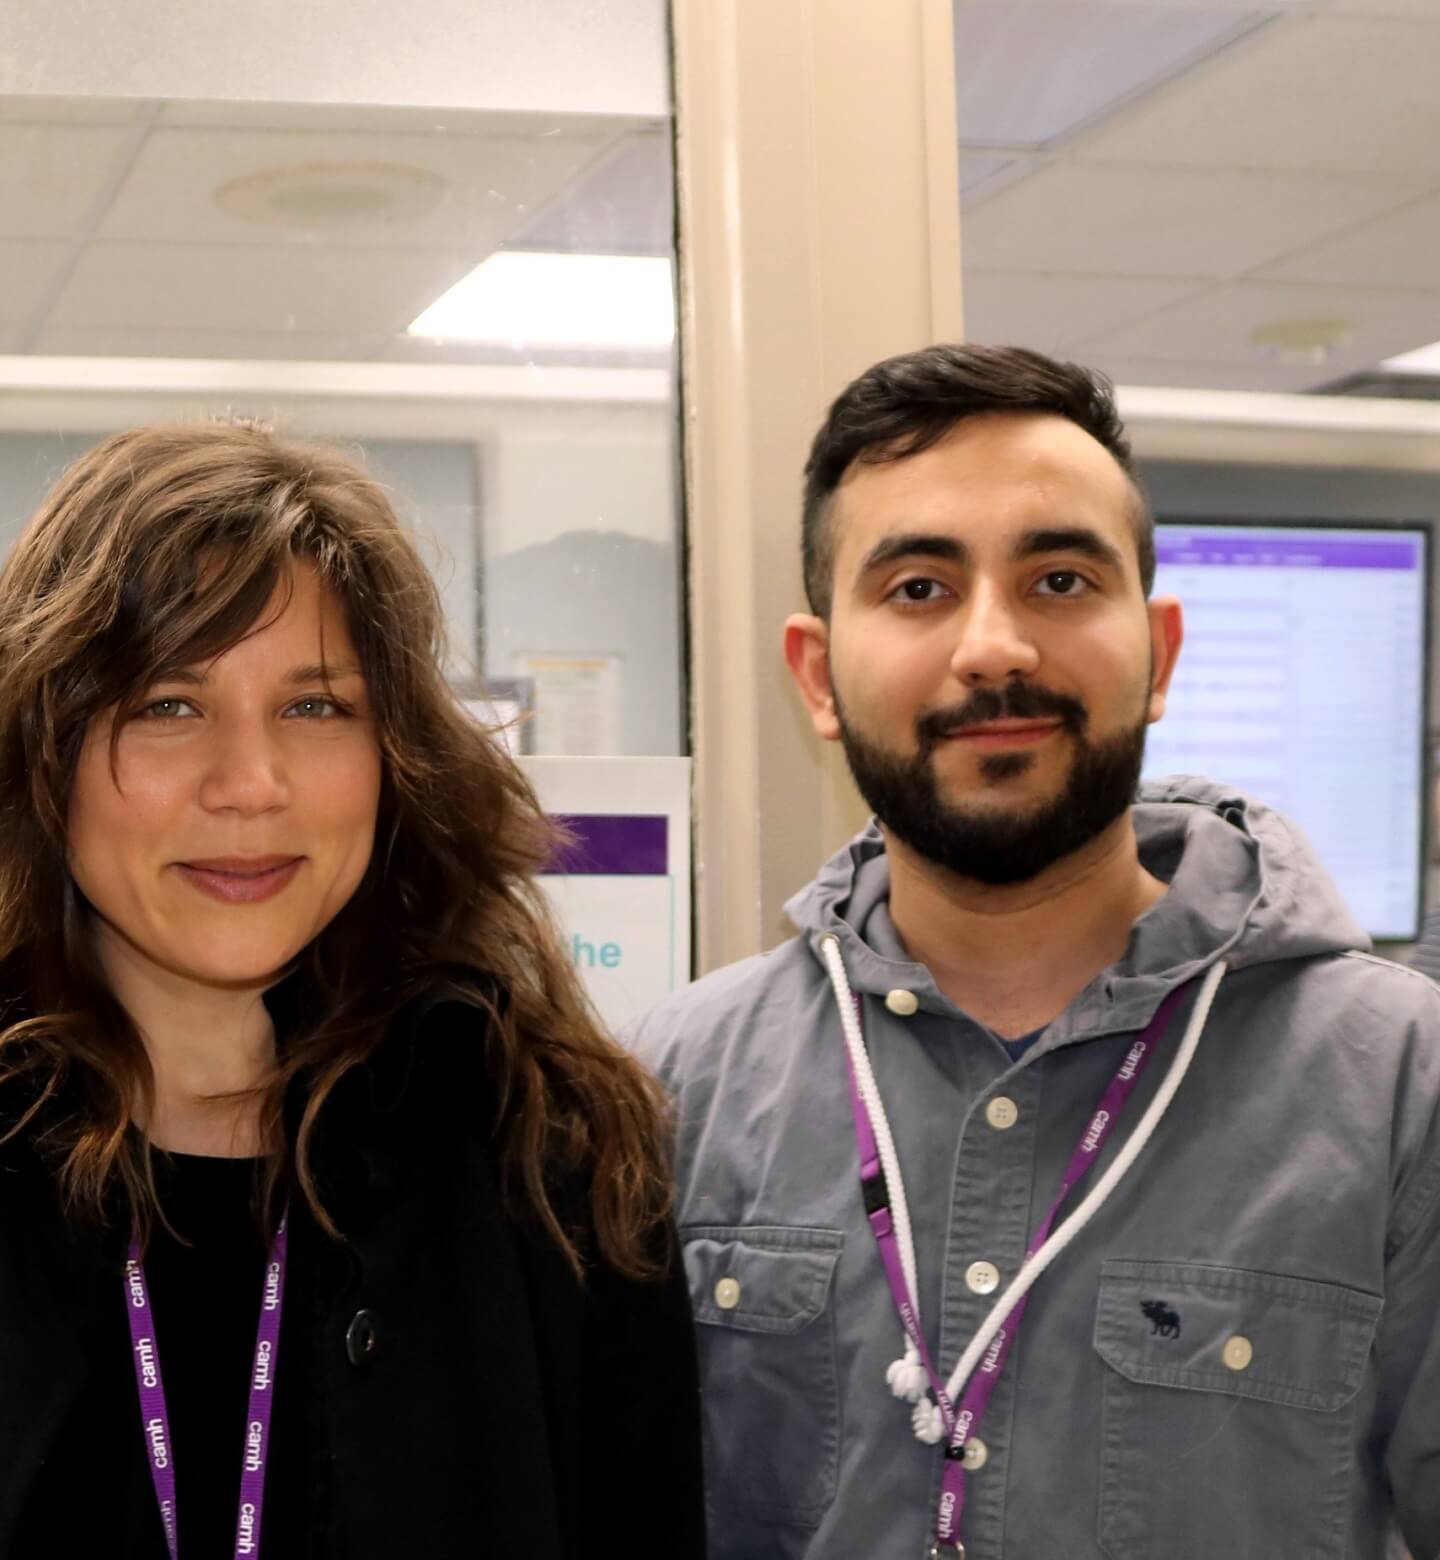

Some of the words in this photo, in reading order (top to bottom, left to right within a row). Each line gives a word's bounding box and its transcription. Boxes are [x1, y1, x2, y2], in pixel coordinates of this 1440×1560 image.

[568, 932, 623, 968] he
[1116, 1041, 1147, 1081] camh
[1081, 1109, 1111, 1153] camh
[263, 1262, 280, 1310] camh
[135, 1338, 157, 1388] camh
[254, 1340, 272, 1391] camh
[981, 1328, 1007, 1374] camh
[146, 1418, 168, 1468] camh
[245, 1421, 263, 1471] camh
[951, 1410, 974, 1447] cam
[238, 1503, 256, 1554] camh
[936, 1491, 956, 1539] camh
